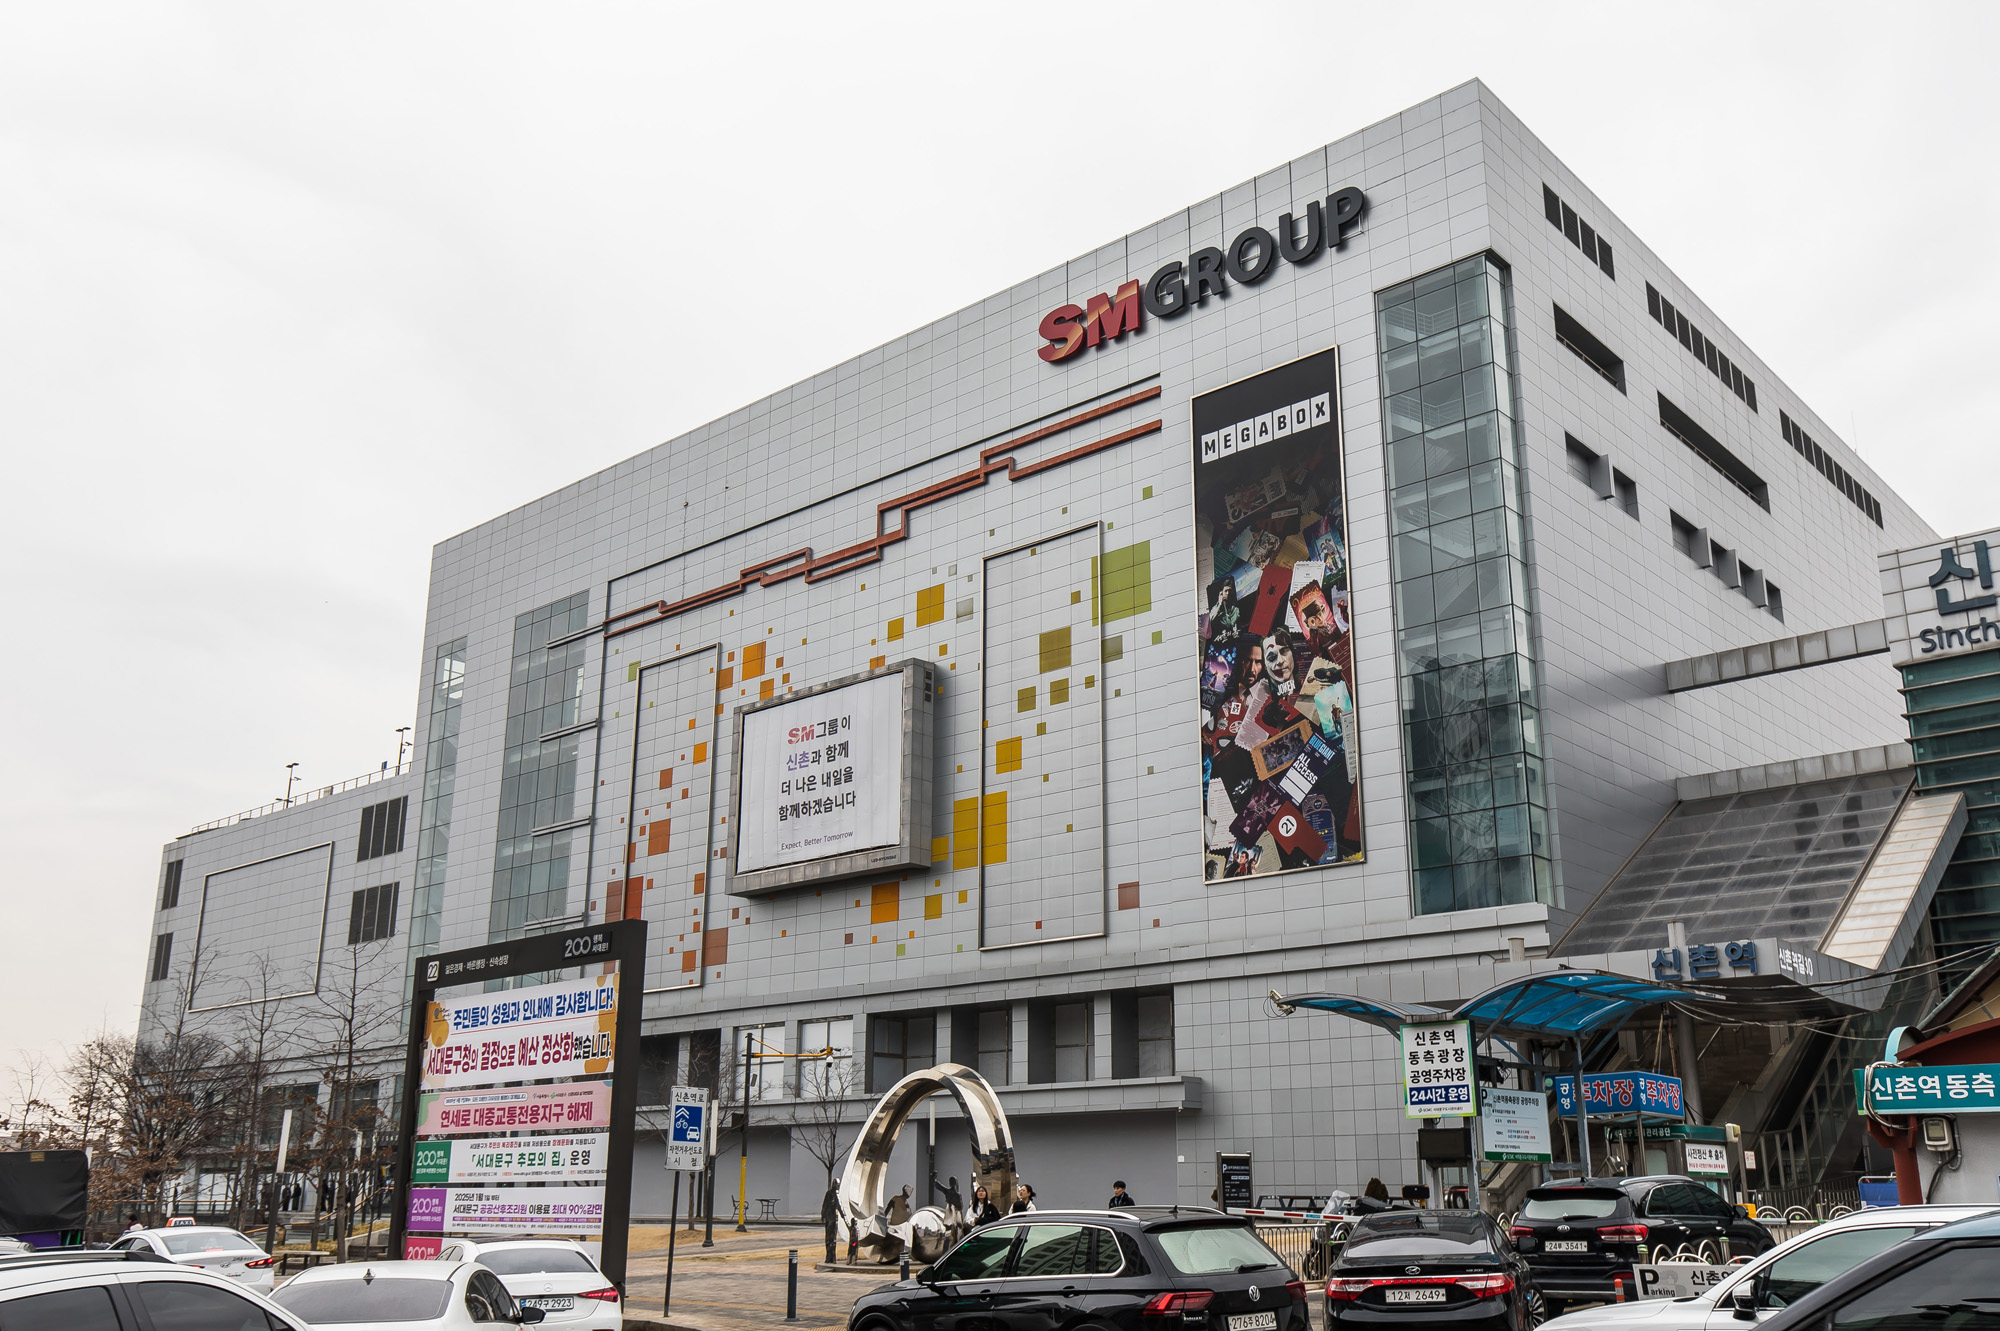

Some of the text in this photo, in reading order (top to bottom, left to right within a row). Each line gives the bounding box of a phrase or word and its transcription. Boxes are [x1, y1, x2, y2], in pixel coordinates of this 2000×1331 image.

[1037, 186, 1365, 362] SM GROUP
[1203, 399, 1326, 457] MEGABOX
[1929, 540, 1997, 616] 신
[1277, 679, 1296, 696] JOKER
[786, 740, 849, 772] 신촌과 함께
[1297, 752, 1311, 768] ALL
[781, 766, 854, 796] 더 나은 내일을
[1292, 760, 1318, 785] ACCESS
[778, 790, 857, 822] 함께하겠습니다
[1281, 818, 1295, 835] 21
[804, 836, 823, 847] Better
[824, 830, 854, 843] Tomorrow
[564, 936, 591, 957] 200
[1652, 940, 1758, 981] 신촌역
[453, 1005, 489, 1030] 주민들의
[491, 1001, 520, 1025] 성원과
[523, 996, 553, 1020] 인내에
[555, 987, 614, 1016] 감사합니다!
[1414, 1030, 1456, 1046] 신촌역
[426, 1043, 479, 1076] 서대문구청의
[480, 1040, 516, 1071] 결정으로
[518, 1035, 539, 1066] 예산
[1409, 1047, 1465, 1065] 동측광장
[1410, 1068, 1466, 1084] 공영주차장
[1411, 1087, 1468, 1102] 24시간 운영
[1646, 1080, 1680, 1110] 주차장
[1871, 1073, 1996, 1100] 신촌역 동측
[675, 1091, 705, 1103] 신촌역로
[441, 1101, 593, 1128] 연세로 대중교통전용지구 해제
[417, 1150, 436, 1166] 200
[517, 1152, 546, 1168] 추모의
[570, 1149, 591, 1166] 운영
[412, 1198, 431, 1213] 200
[455, 1193, 474, 1201] 2025년
[475, 1193, 484, 1201] 1월
[453, 1204, 479, 1214] 서대문구
[480, 1204, 528, 1214] 공공산후조리원
[529, 1204, 550, 1214] 이용료
[552, 1204, 567, 1215] 최대
[551, 1299, 572, 1308] 2923
[1415, 1289, 1440, 1300] 2649
[1231, 1312, 1275, 1330] 276주 8204
